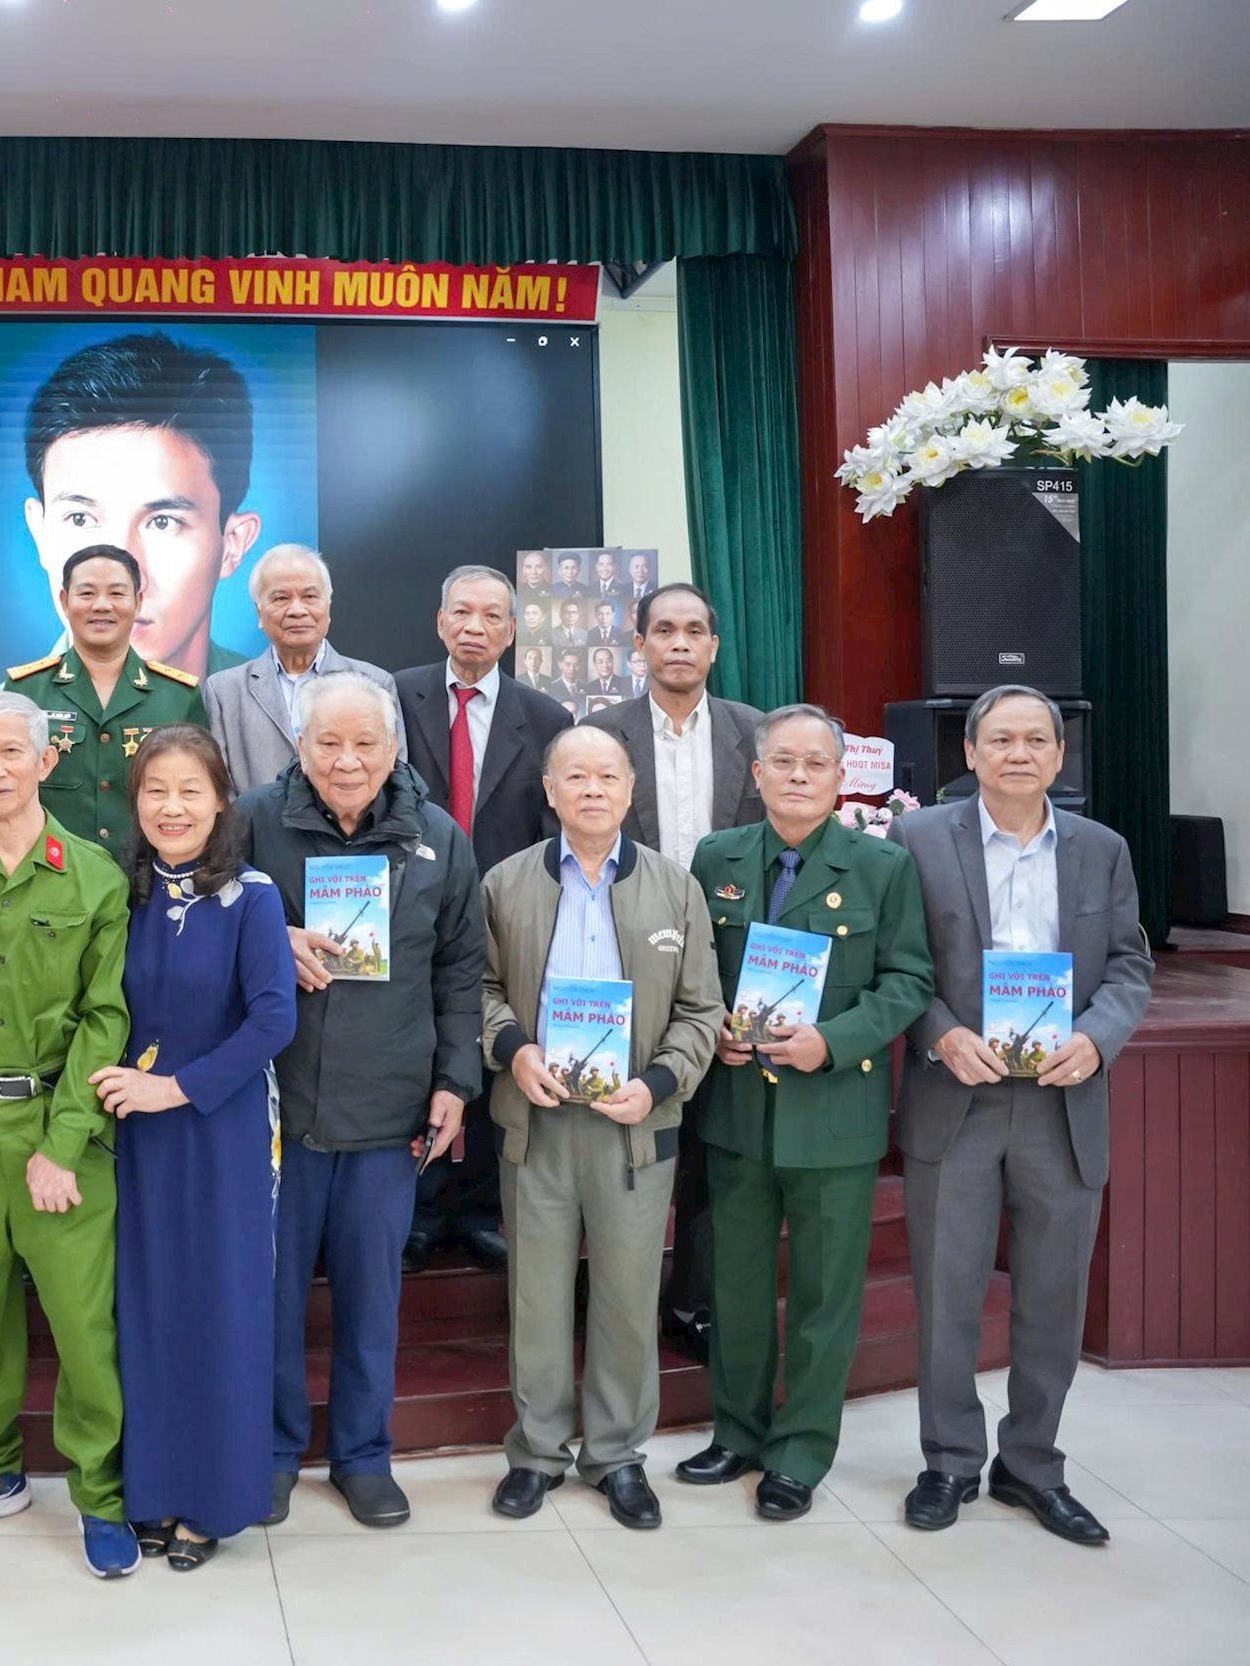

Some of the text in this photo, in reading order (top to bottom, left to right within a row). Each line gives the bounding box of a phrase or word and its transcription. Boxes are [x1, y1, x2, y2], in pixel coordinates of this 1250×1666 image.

[81, 267, 215, 307] QUANG
[229, 269, 320, 306] VINH
[333, 264, 448, 309] MUÔN
[1036, 480, 1073, 492] SP415
[870, 760, 891, 770] MISA
[309, 883, 382, 899] MÂM PHÁO
[748, 953, 778, 969] MÂM
[781, 961, 818, 977] PHÁO
[989, 982, 1067, 998] MÂM PHÁO
[552, 1007, 626, 1026] MÂM PHÁO
